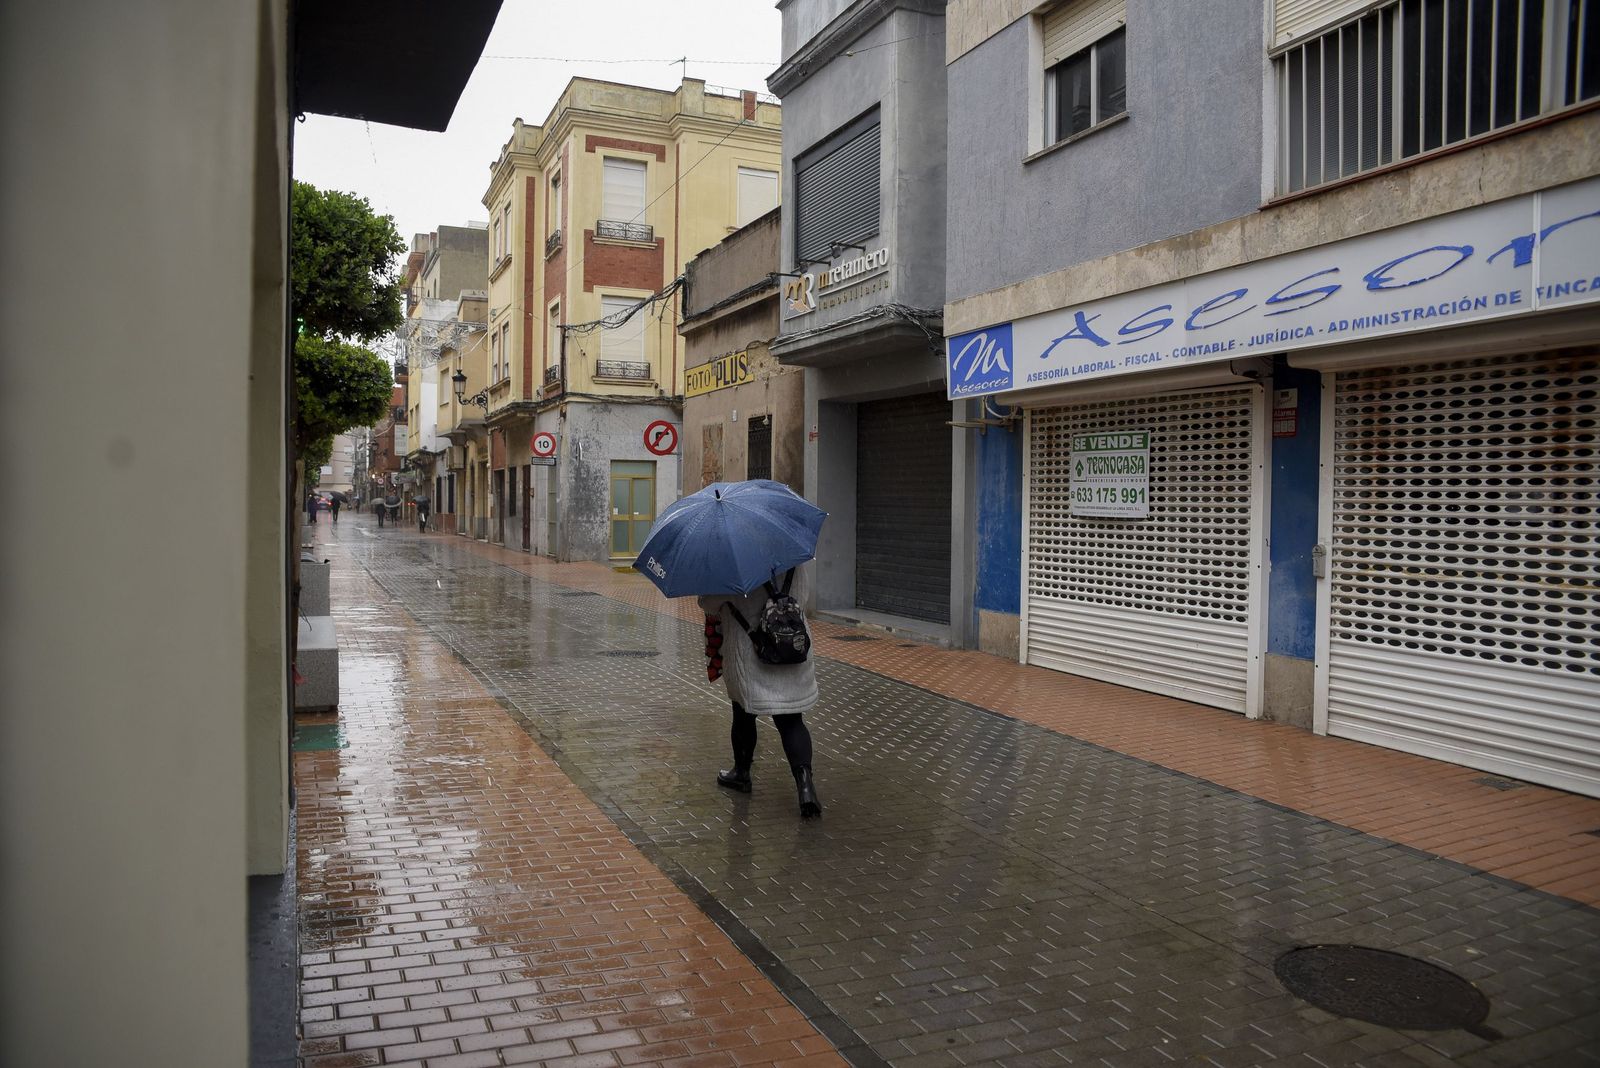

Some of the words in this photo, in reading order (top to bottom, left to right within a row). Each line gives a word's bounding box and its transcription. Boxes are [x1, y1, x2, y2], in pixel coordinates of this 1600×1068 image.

[818, 247, 889, 291] mretamero
[1026, 364, 1069, 383] ASESORÍA
[1071, 360, 1116, 375] LABORAL
[1124, 354, 1162, 367] FISCAL
[1172, 340, 1236, 359] CONTABLE
[1247, 326, 1315, 348] JURÍDICA
[1494, 290, 1522, 306] DE
[686, 369, 711, 392] FOTO
[715, 354, 748, 388] PLUS
[952, 376, 1009, 395] Asesores
[538, 440, 550, 449] 10
[1074, 437, 1087, 450] SE
[1089, 434, 1144, 449] VENDE
[1086, 455, 1145, 475] TECNOCASA
[1077, 487, 1093, 503] 633
[1096, 487, 1117, 504] 175
[1121, 487, 1145, 504] 991
